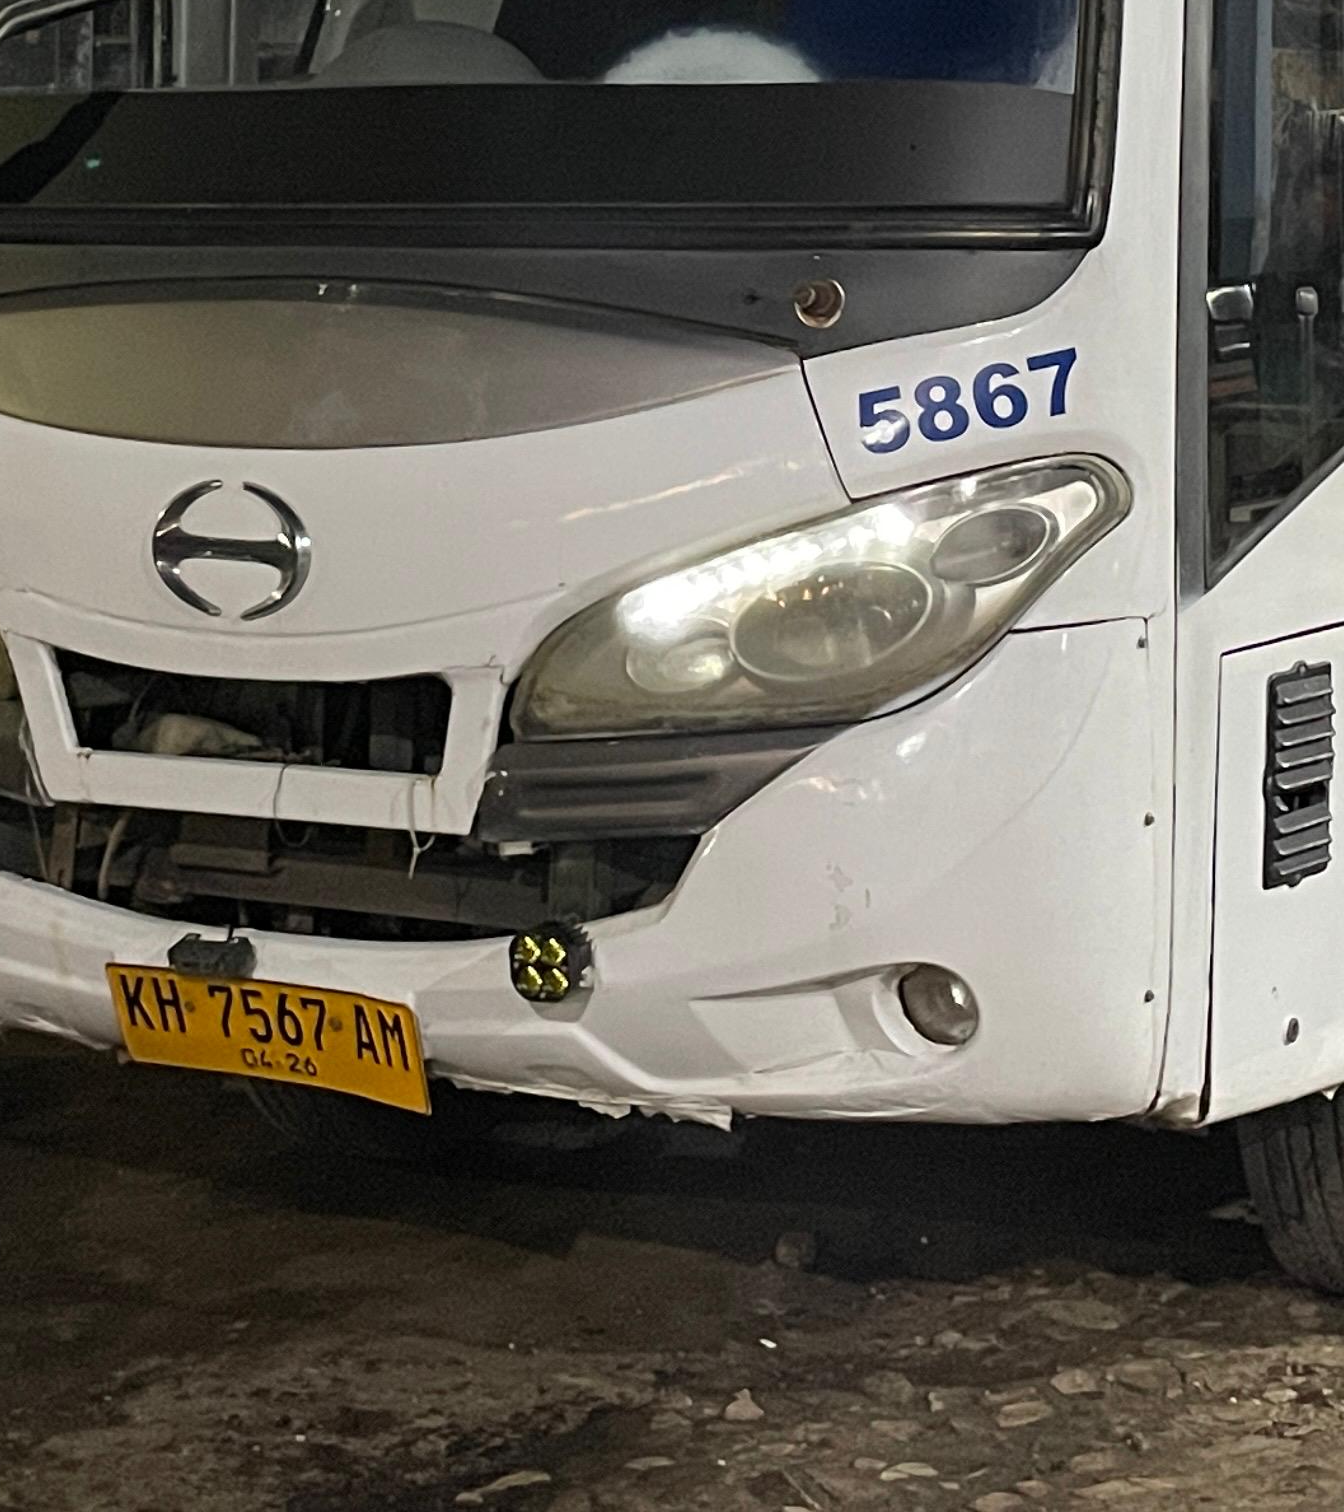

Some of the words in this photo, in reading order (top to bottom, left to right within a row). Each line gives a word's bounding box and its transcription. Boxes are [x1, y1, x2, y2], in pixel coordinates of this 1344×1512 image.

[859, 347, 1077, 454] 5867
[120, 974, 188, 1033] KH
[208, 985, 326, 1051] 7567
[354, 1003, 410, 1071] AM
